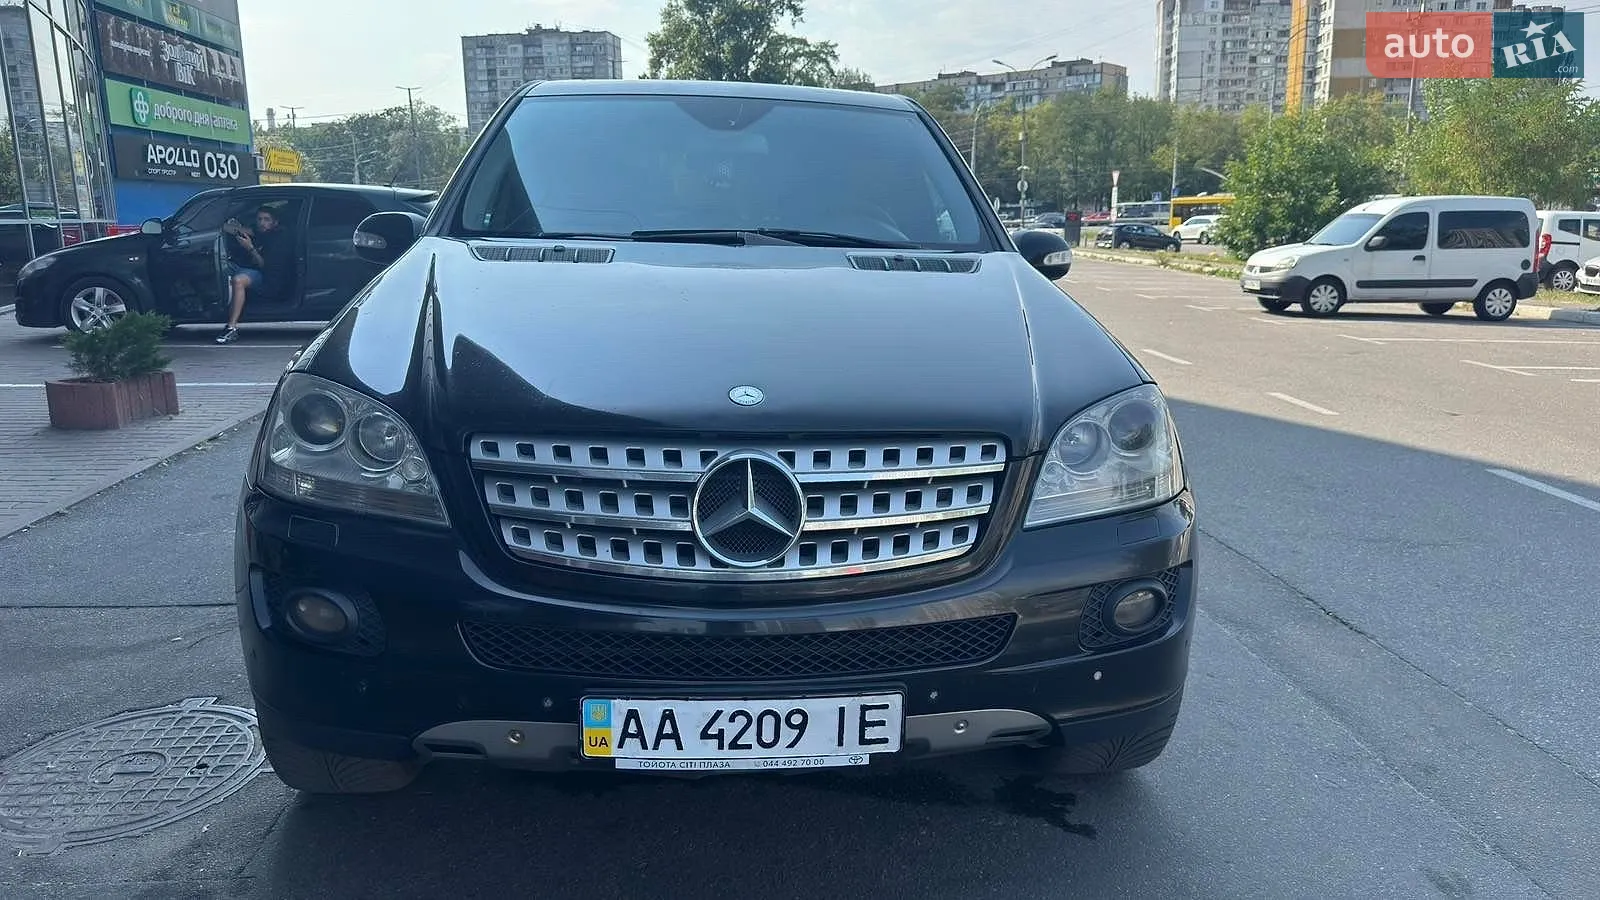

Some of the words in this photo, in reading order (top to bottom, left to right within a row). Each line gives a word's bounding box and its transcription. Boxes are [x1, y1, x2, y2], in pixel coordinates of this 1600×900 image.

[154, 101, 193, 122] доброго
[193, 109, 209, 127] дня
[212, 115, 239, 131] аптека
[147, 143, 200, 168] APOLLO
[617, 708, 684, 750] AA
[700, 708, 809, 750] 4209
[837, 703, 890, 747] IE
[588, 736, 609, 748] UA
[638, 760, 677, 769] ТОЙОТА
[699, 760, 731, 769] ПЛАЗА
[762, 760, 779, 768] 044
[782, 759, 797, 767] 492
[800, 759, 812, 767] 70
